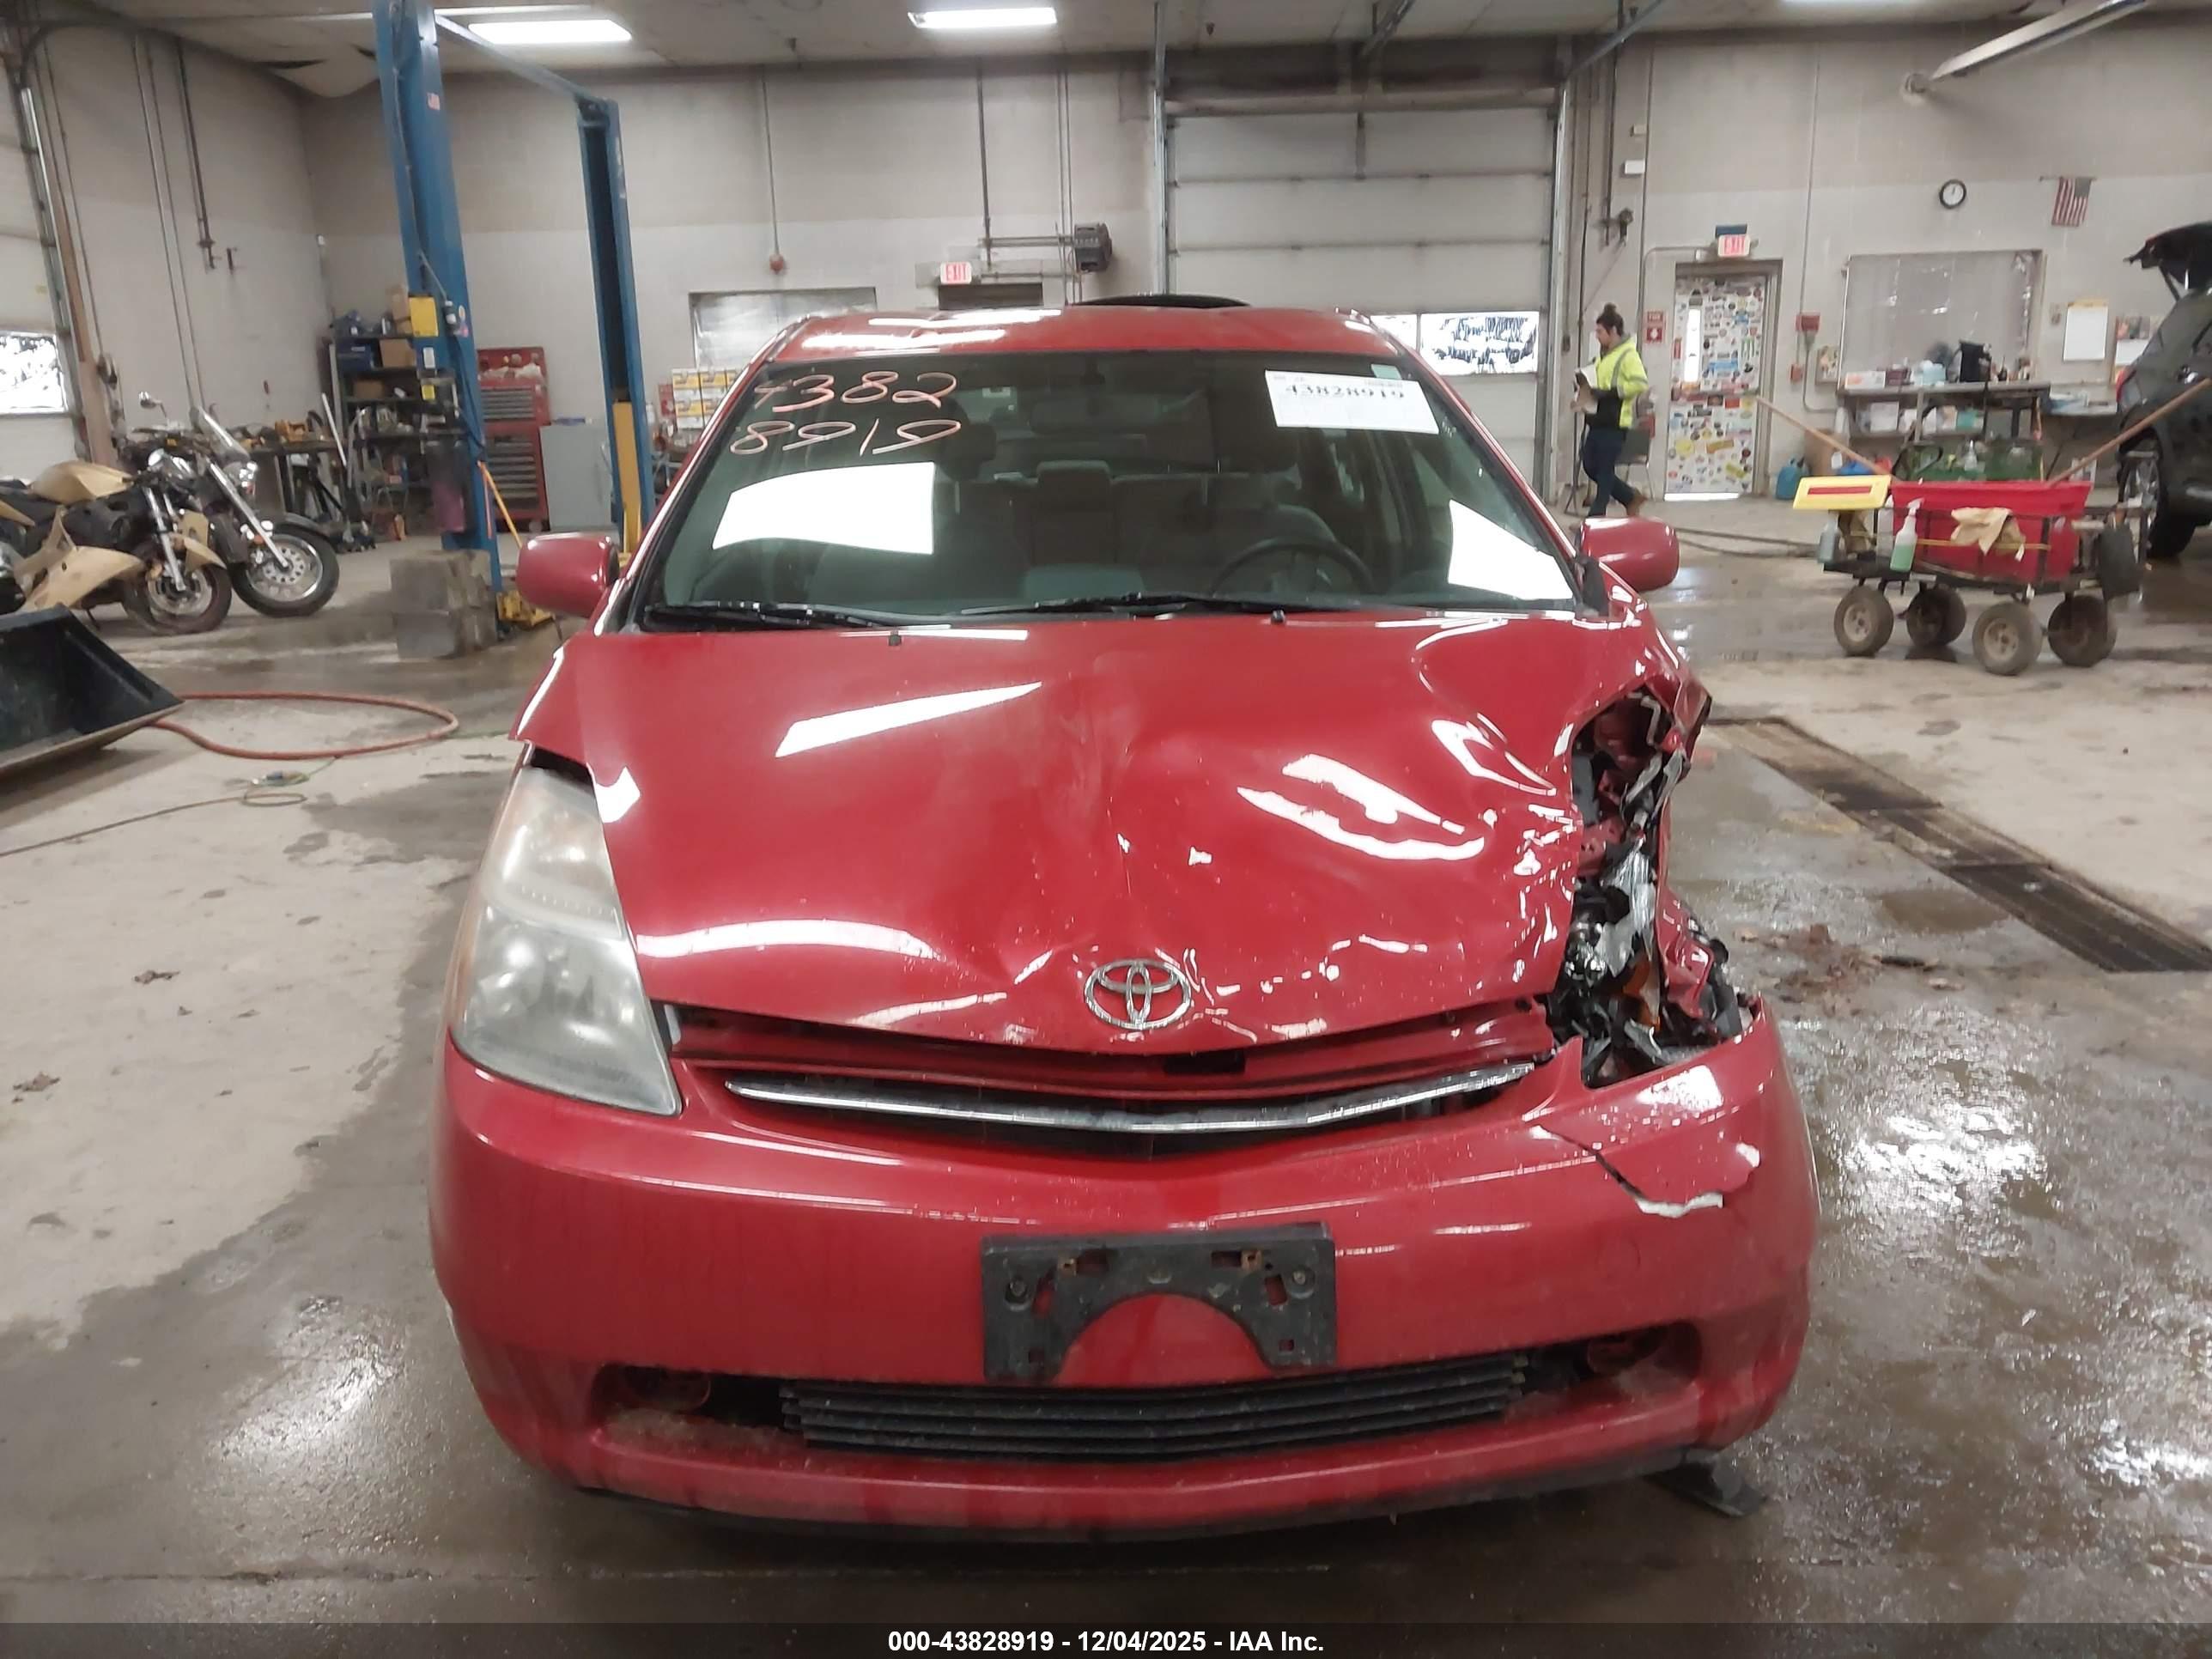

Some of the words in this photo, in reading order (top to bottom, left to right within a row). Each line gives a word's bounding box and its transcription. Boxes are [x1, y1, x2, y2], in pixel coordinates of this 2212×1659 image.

[1723, 234, 1746, 255] EXIT
[945, 262, 968, 283] EXIT
[730, 418, 962, 457] 8919
